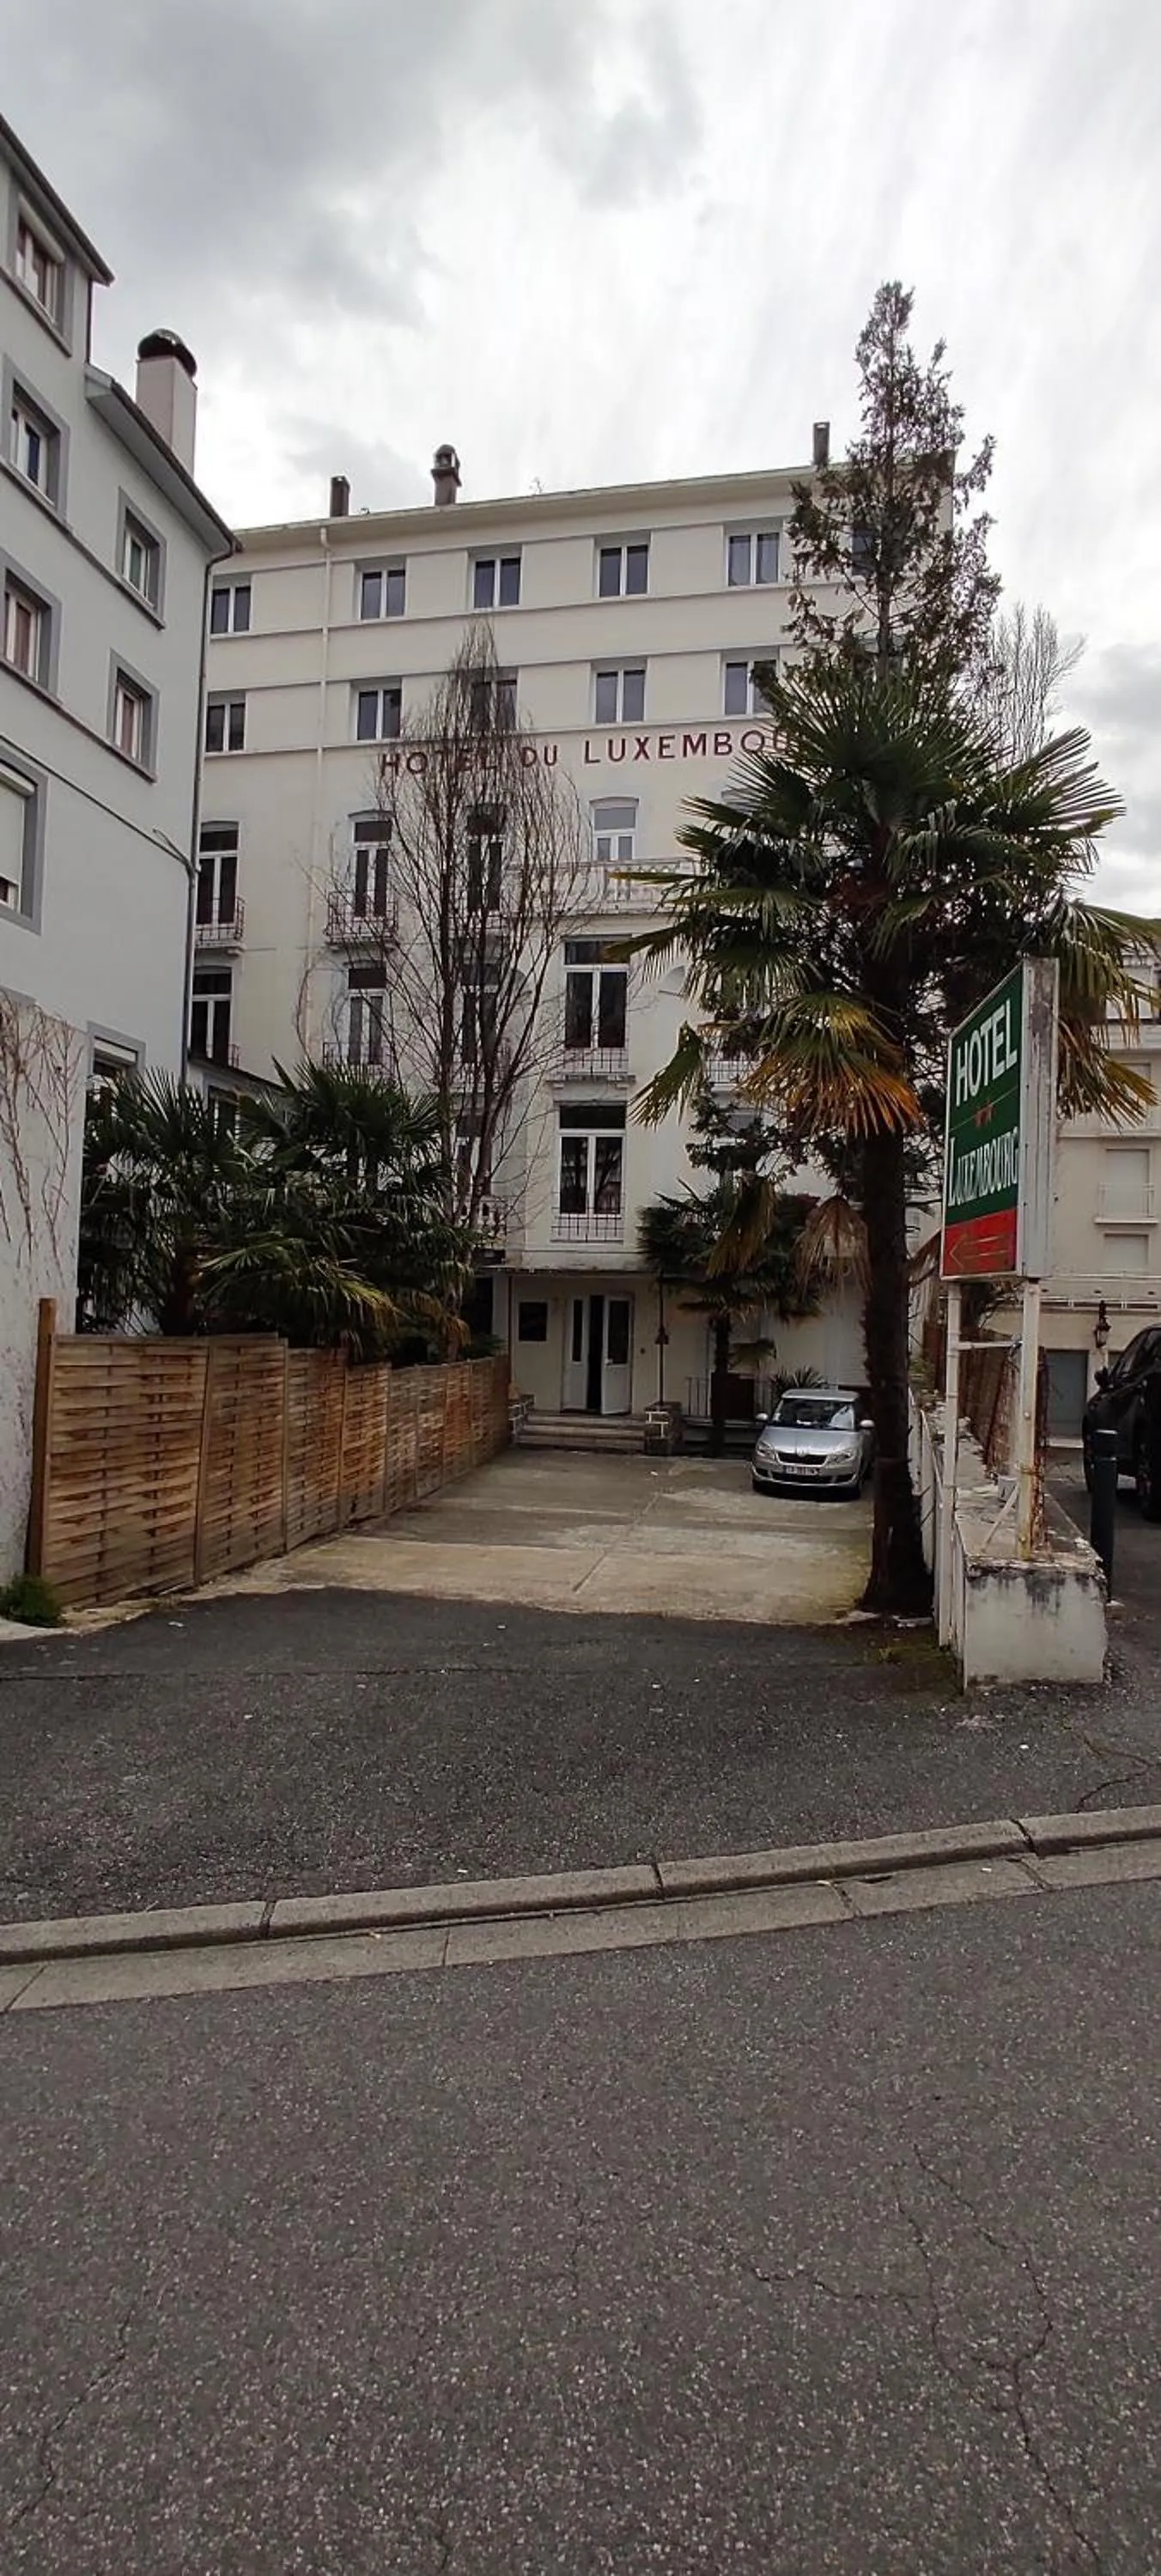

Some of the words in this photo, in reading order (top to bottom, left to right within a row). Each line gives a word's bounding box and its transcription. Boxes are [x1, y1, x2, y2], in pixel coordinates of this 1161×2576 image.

[380, 745, 498, 776] HOTEL
[522, 744, 558, 768] DU
[584, 727, 790, 763] LUXEMBOU
[955, 999, 1018, 1108] HOTEL
